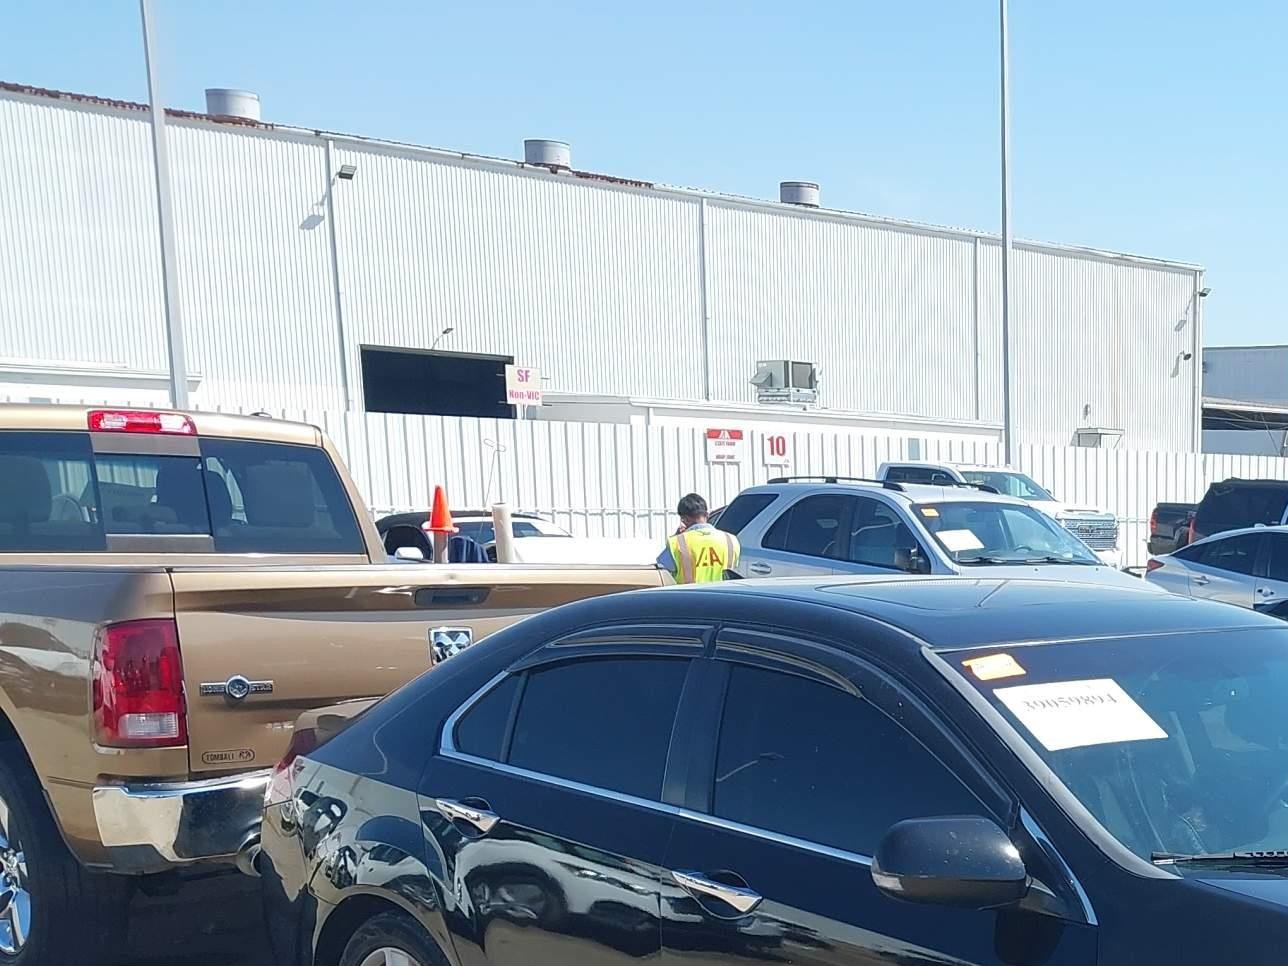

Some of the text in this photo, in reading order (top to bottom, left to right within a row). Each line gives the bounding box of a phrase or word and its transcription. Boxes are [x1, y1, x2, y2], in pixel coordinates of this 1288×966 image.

[517, 369, 531, 383] SF
[509, 389, 540, 401] Non-VIC
[767, 435, 786, 457] 10
[1022, 693, 1119, 712] 39059894
